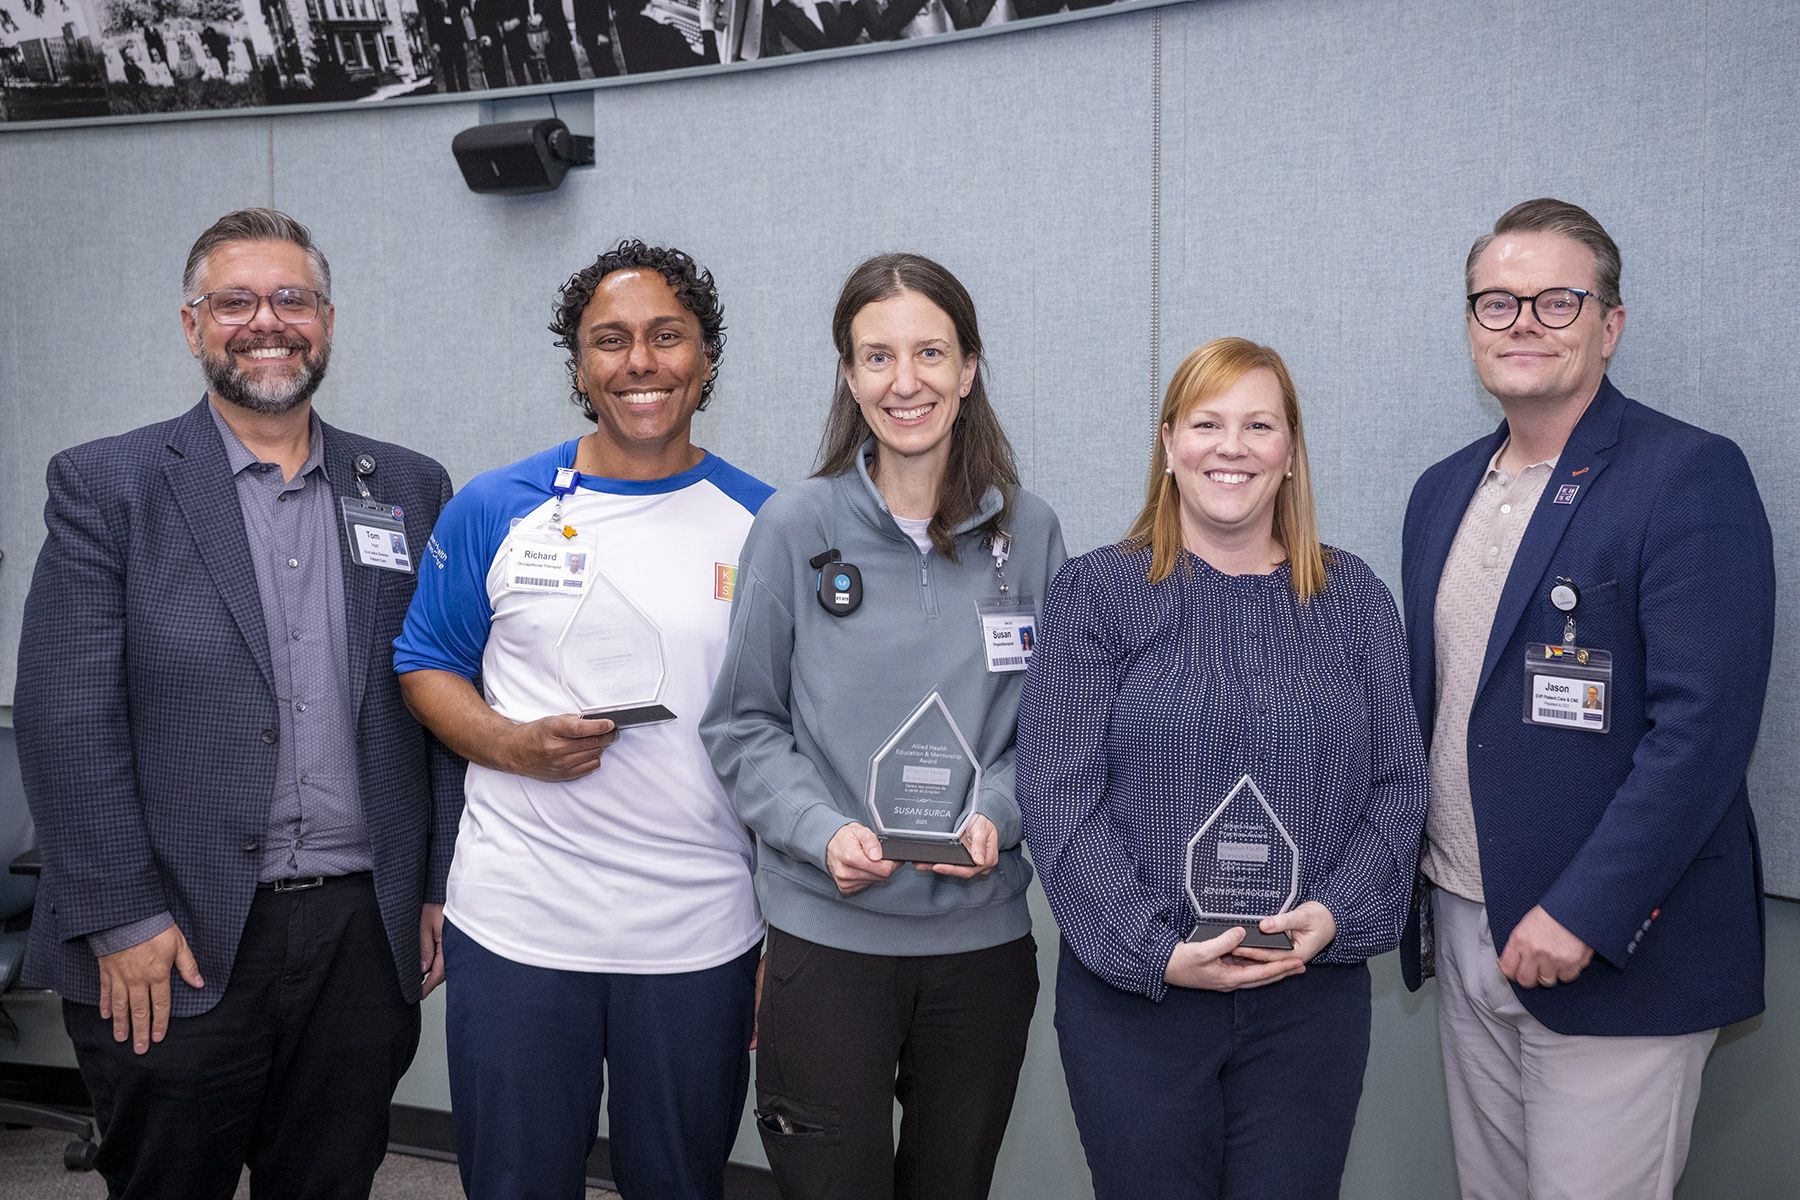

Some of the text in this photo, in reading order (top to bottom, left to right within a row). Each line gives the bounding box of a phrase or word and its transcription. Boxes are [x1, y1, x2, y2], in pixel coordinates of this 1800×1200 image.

[366, 530, 381, 540] Tom
[524, 550, 558, 561] Richard
[992, 630, 1012, 639] Susan
[1545, 682, 1570, 693] Jason
[896, 748, 924, 757] Education
[930, 752, 962, 760] Mentorship
[919, 757, 938, 765] Award
[893, 806, 952, 818] SUSAN SURCA
[1245, 888, 1281, 898] ROGERS
